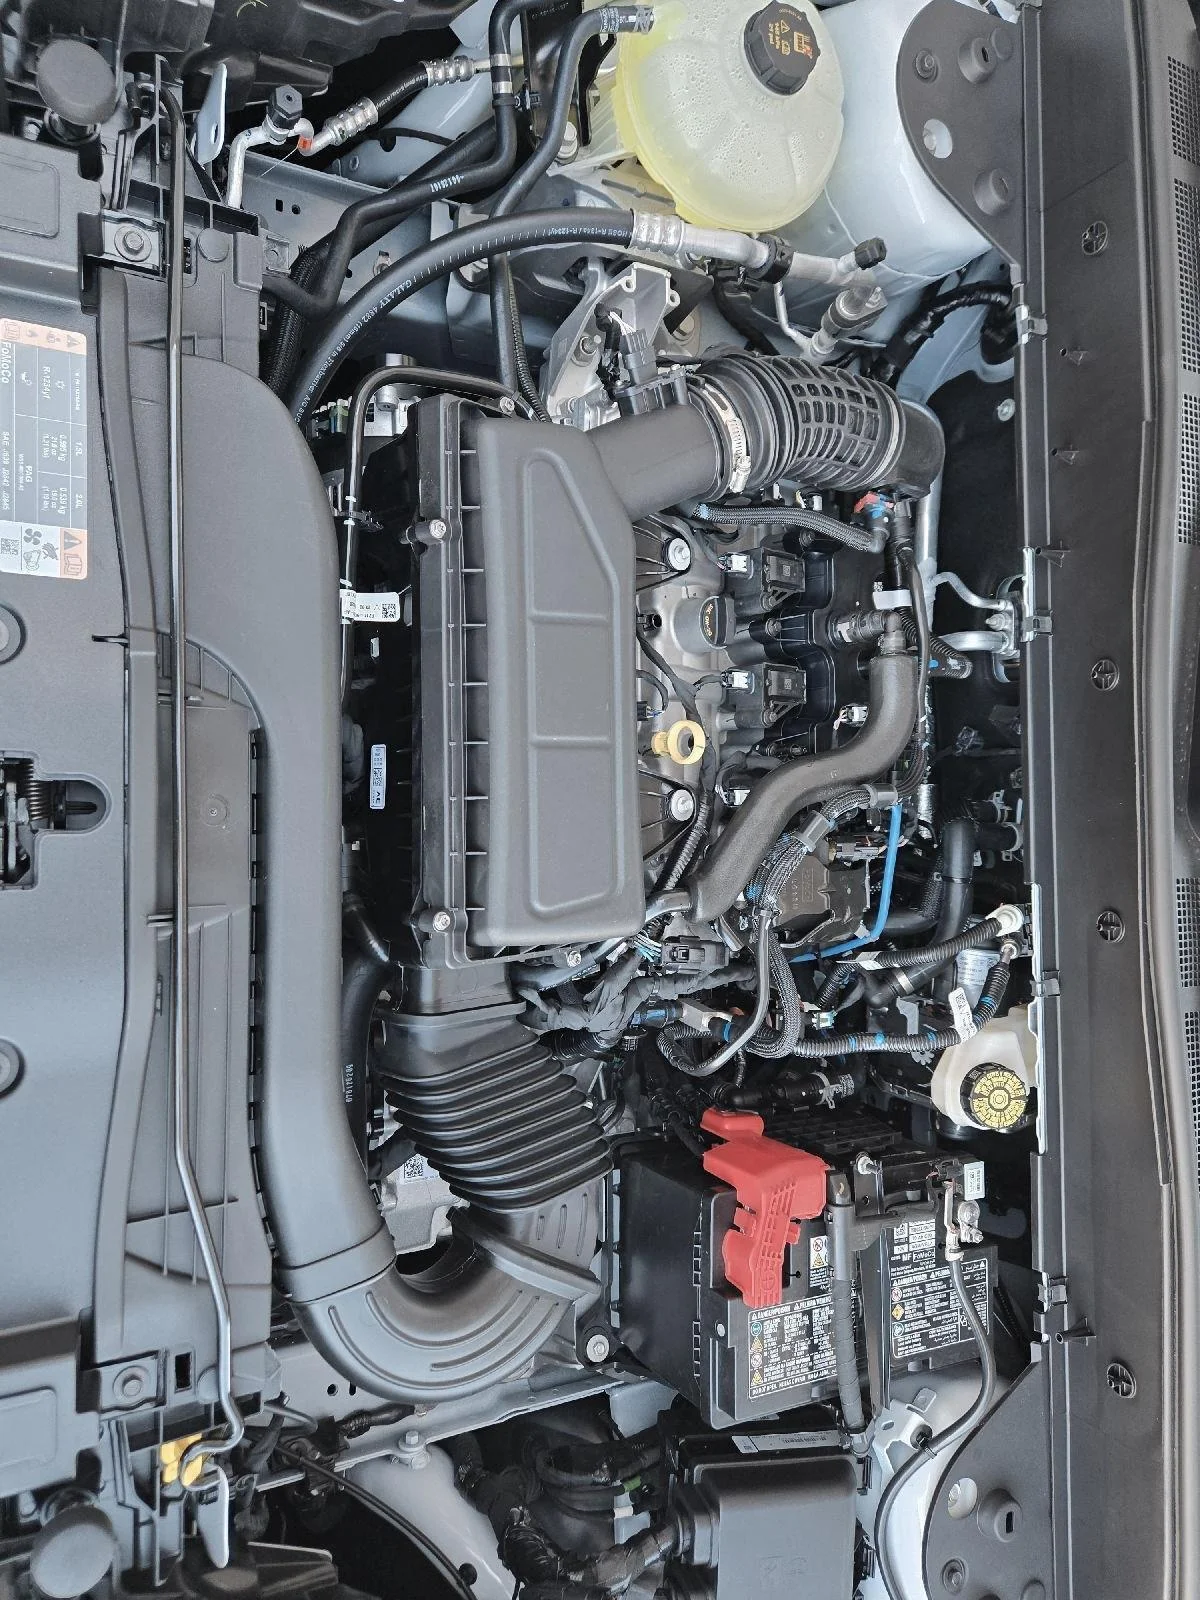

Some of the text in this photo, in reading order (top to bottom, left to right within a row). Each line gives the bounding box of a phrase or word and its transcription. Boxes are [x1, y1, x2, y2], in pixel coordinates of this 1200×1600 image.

[379, 279, 412, 308] GALAXY
[1, 341, 12, 384] FoMoCo
[42, 366, 51, 400] R-1234yf
[308, 356, 335, 394] Flexbarrier
[300, 394, 311, 407] A/C
[58, 454, 67, 462] kg
[58, 505, 67, 515] kg
[914, 1250, 935, 1260] FoMoCo
